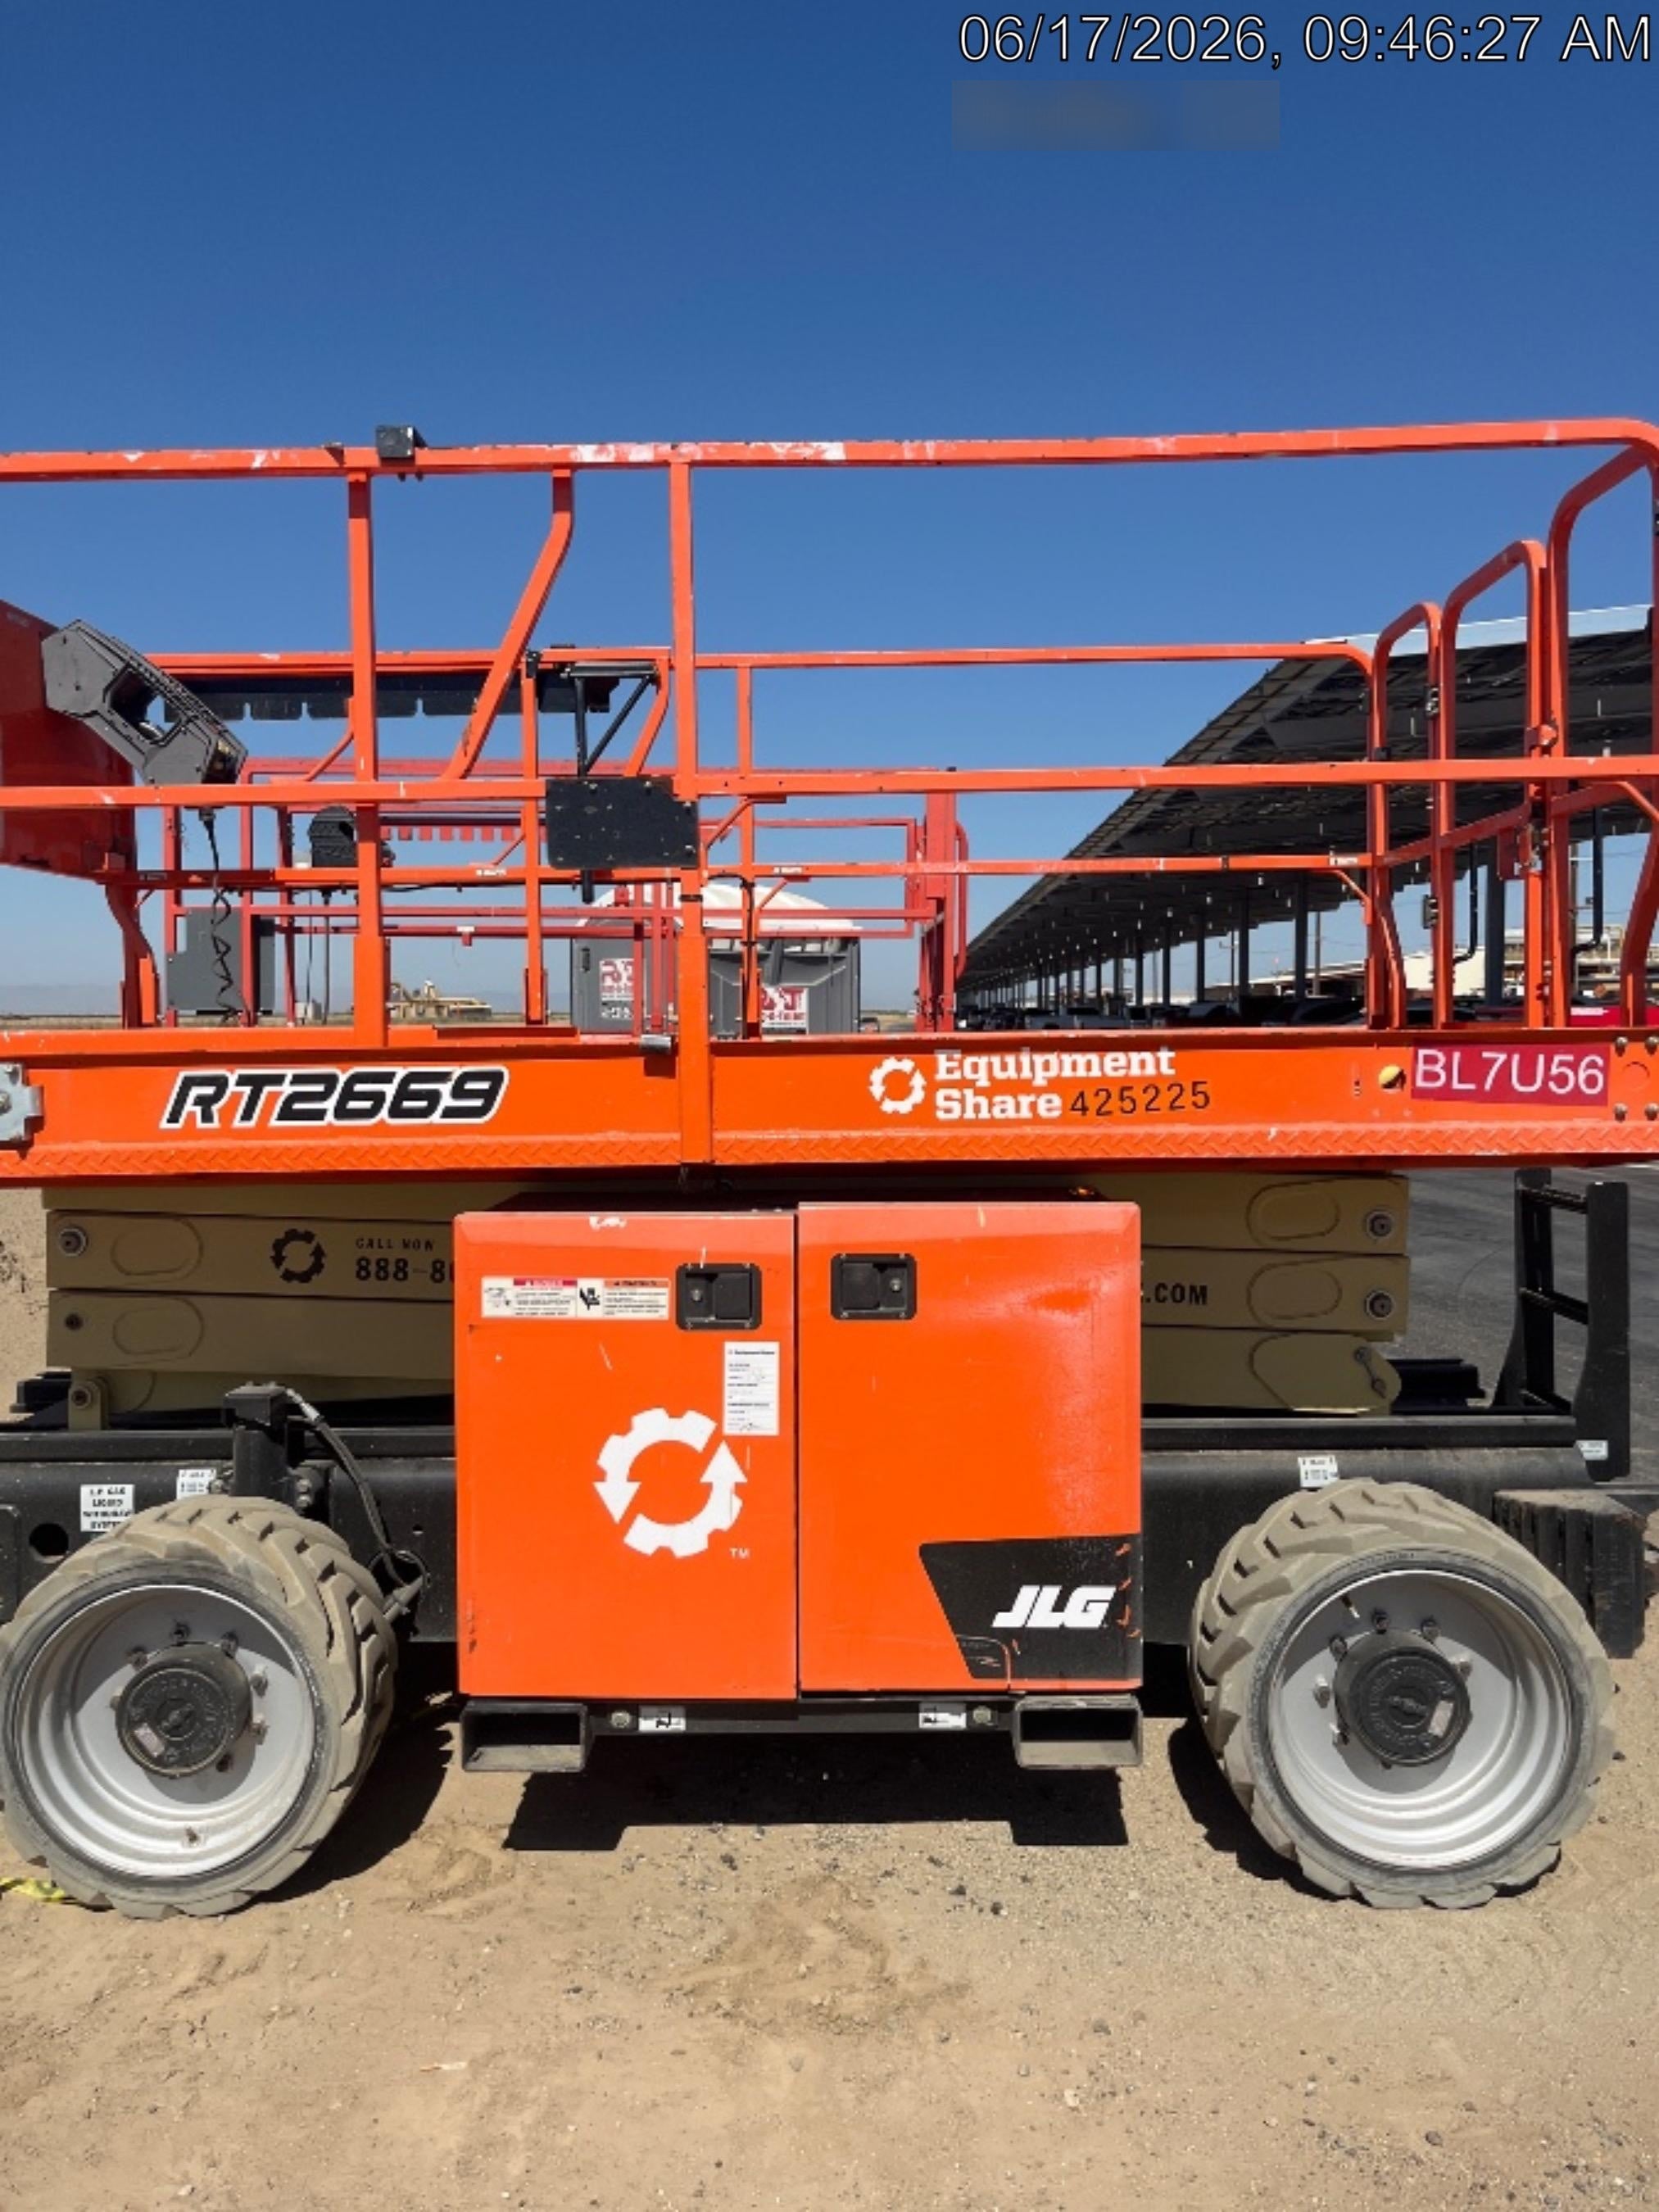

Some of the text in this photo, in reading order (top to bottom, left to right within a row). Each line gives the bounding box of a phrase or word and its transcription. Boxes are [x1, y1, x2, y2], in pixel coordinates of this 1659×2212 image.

[934, 1047, 1176, 1087] Equipment
[1415, 1049, 1605, 1095] BL7U56
[161, 1067, 508, 1128] RT2669
[935, 1080, 1212, 1121] Share 425225
[356, 1238, 394, 1249] CALL
[356, 1257, 455, 1284] 888-8
[991, 1584, 1117, 1629] JLG
